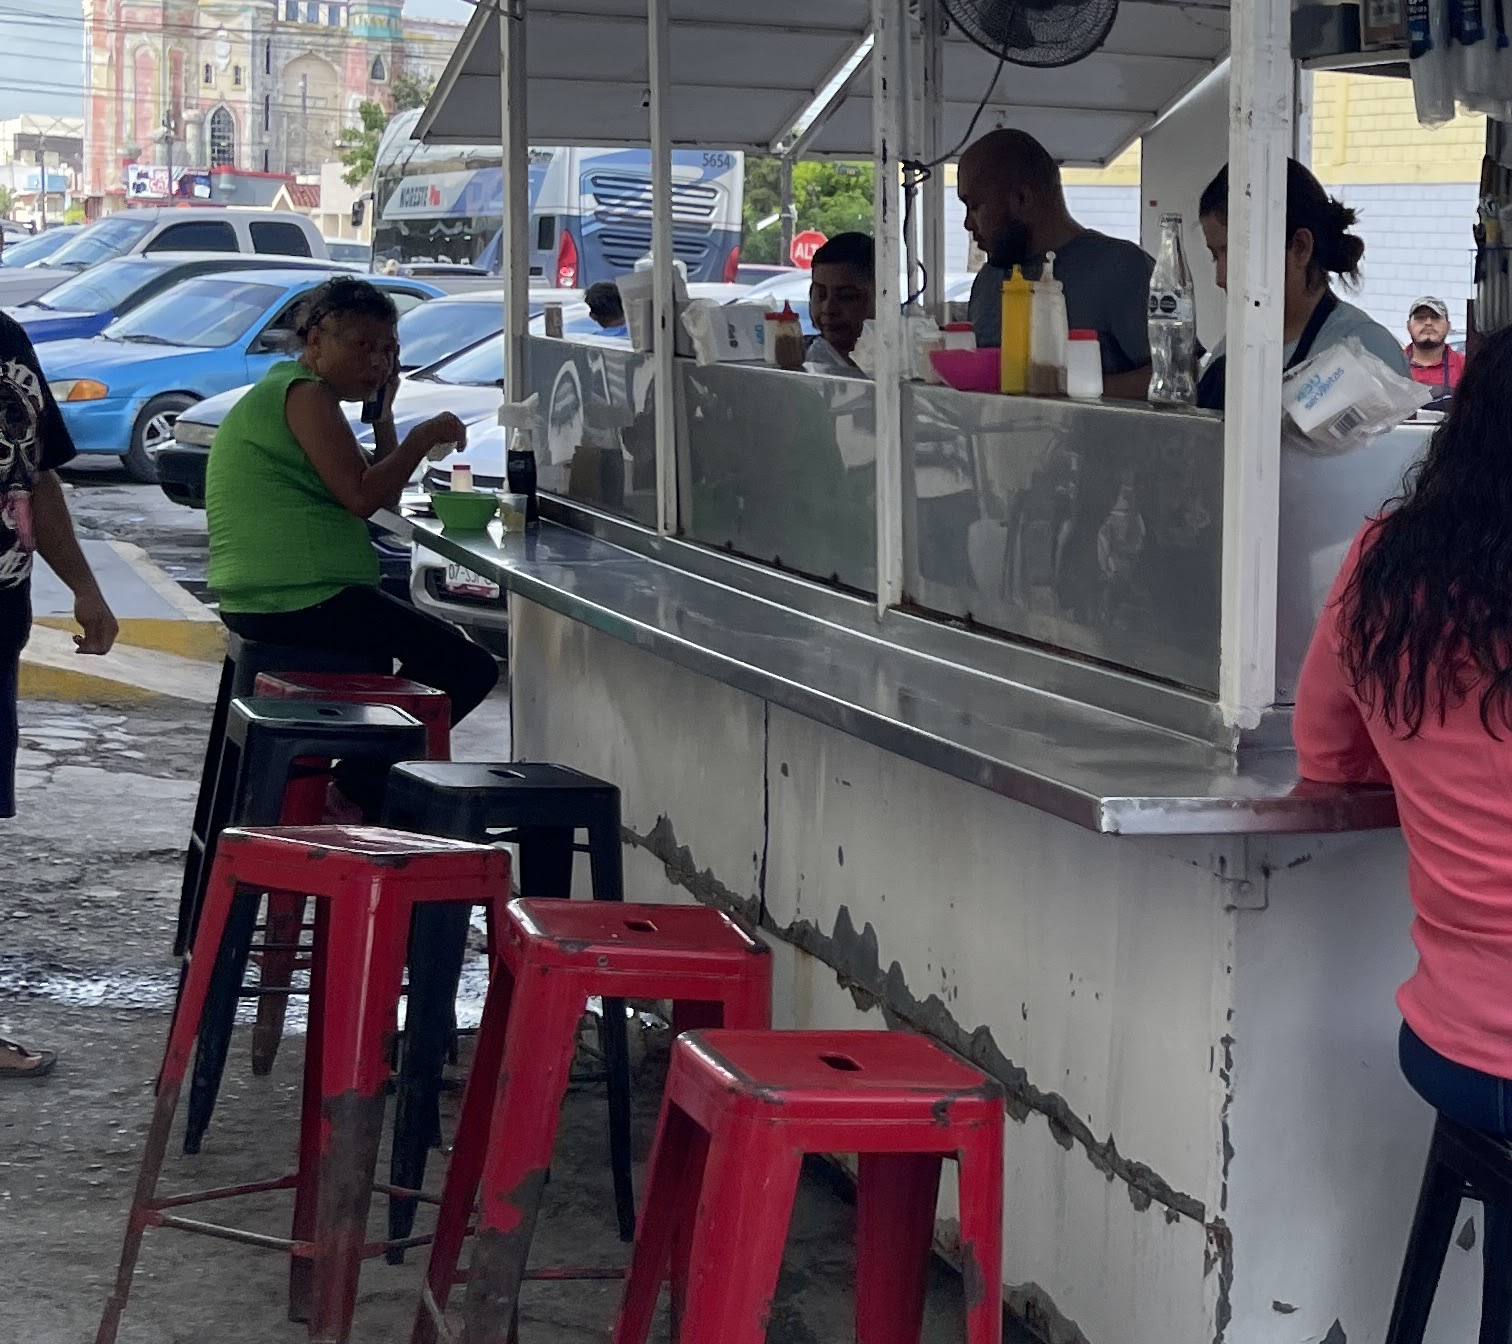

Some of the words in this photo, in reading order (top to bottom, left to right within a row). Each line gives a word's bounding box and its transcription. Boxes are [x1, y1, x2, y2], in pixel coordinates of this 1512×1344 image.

[702, 152, 730, 169] 5654
[400, 186, 429, 208] NORESTE
[794, 242, 819, 261] ALT
